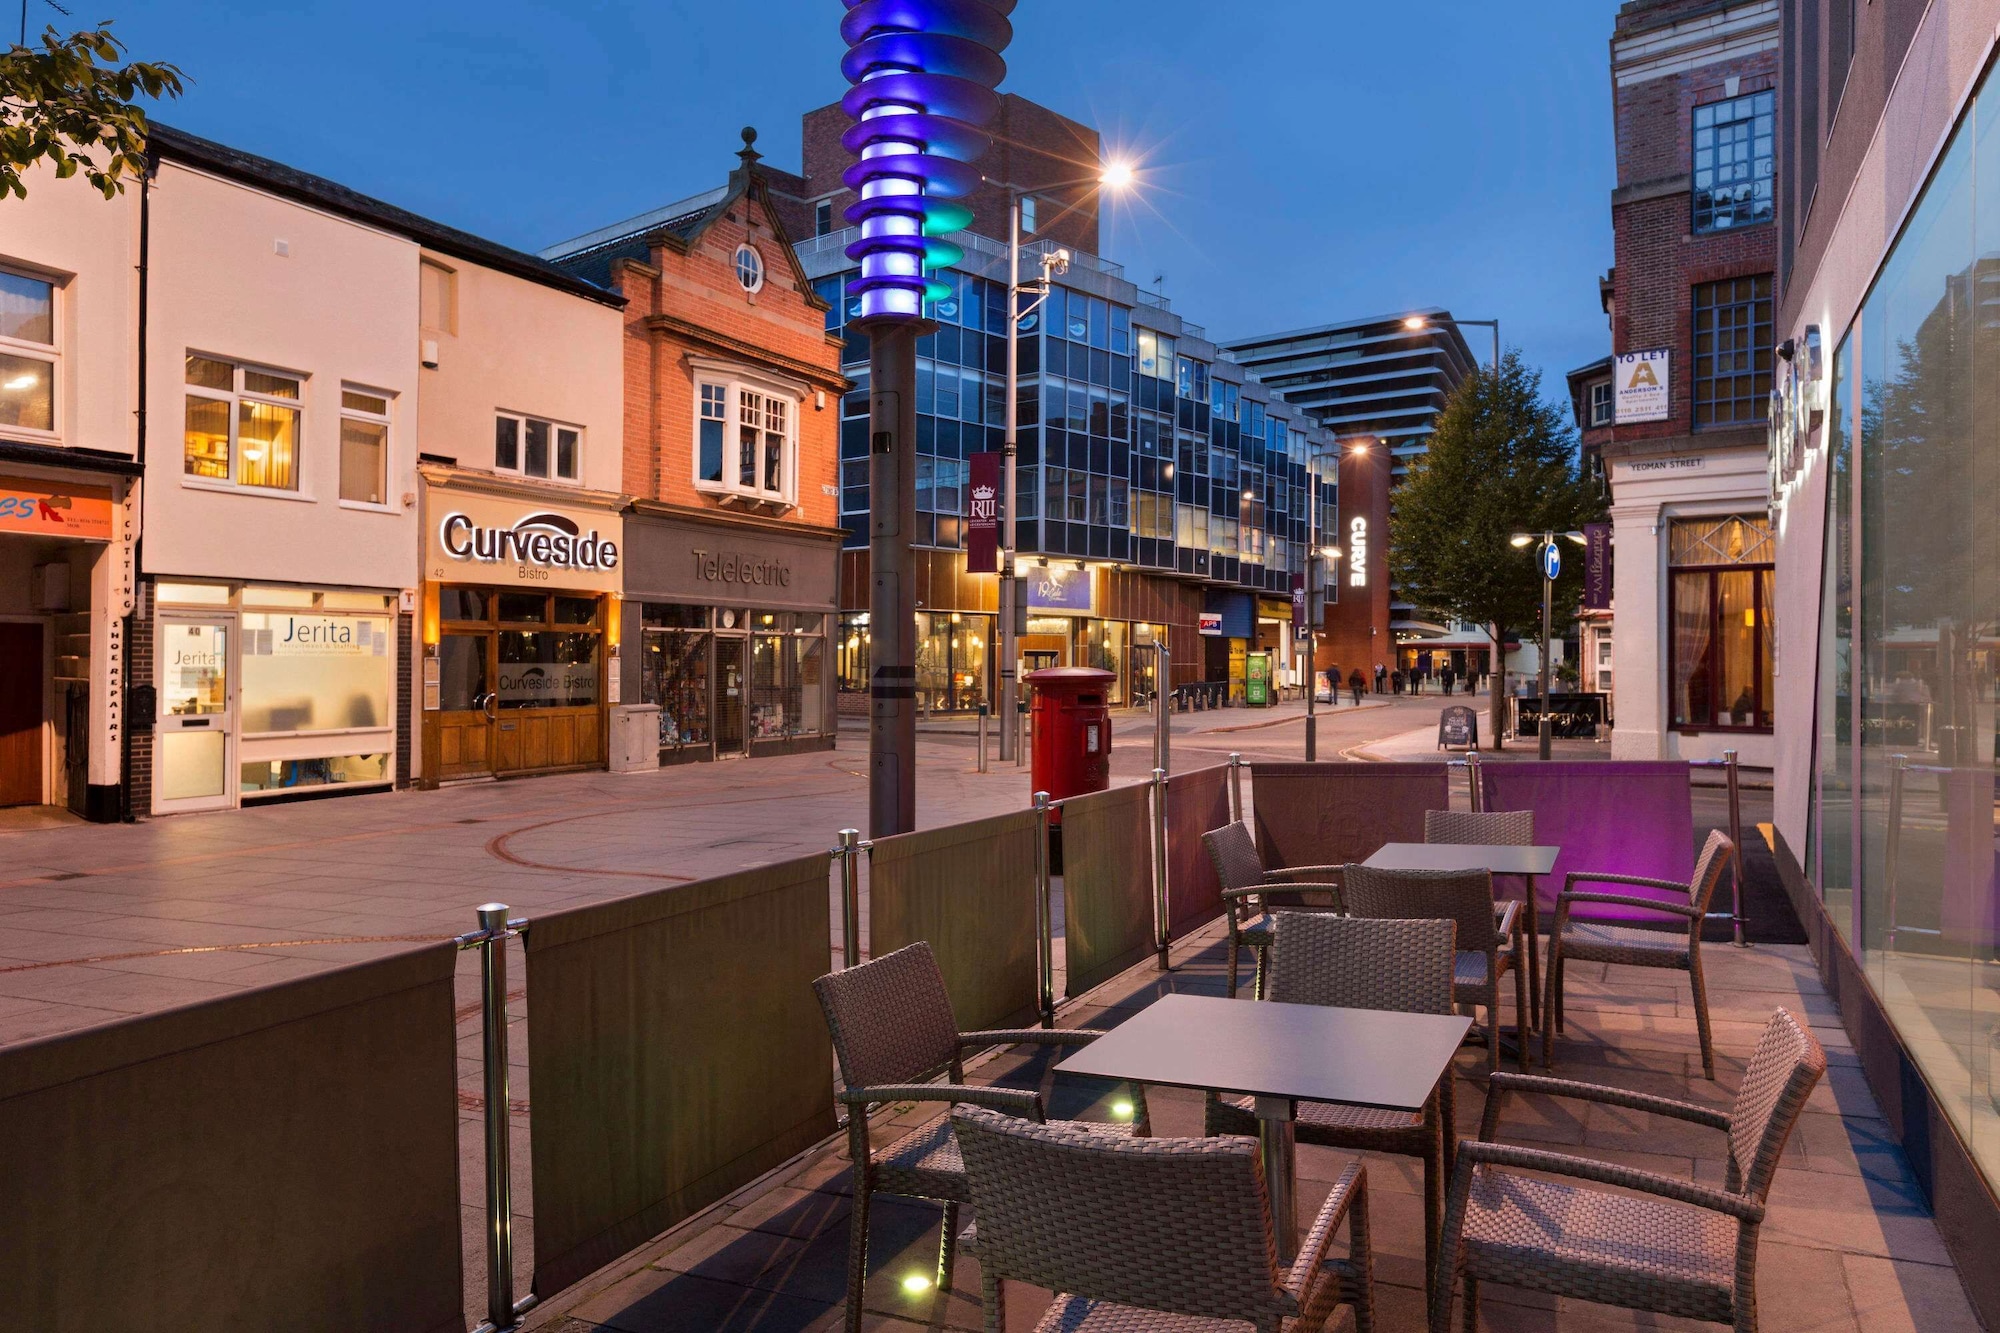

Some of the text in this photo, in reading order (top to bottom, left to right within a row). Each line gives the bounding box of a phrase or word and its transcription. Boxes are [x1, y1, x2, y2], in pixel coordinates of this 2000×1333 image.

[1618, 350, 1667, 364] TO LET
[1631, 458, 1702, 471] YEOMAN STREET
[441, 513, 618, 569] Curveside
[1350, 516, 1367, 587] CURVE
[124, 520, 132, 608] CUTTING
[434, 568, 445, 577] 42
[692, 549, 790, 587] Telelectric
[518, 566, 549, 580] Bistro
[188, 627, 201, 636] 40
[283, 617, 351, 643] Jerita
[174, 650, 216, 665] Jerita
[109, 621, 119, 741] SHOE REPAIRS
[500, 674, 595, 691] Curveside Bistro
